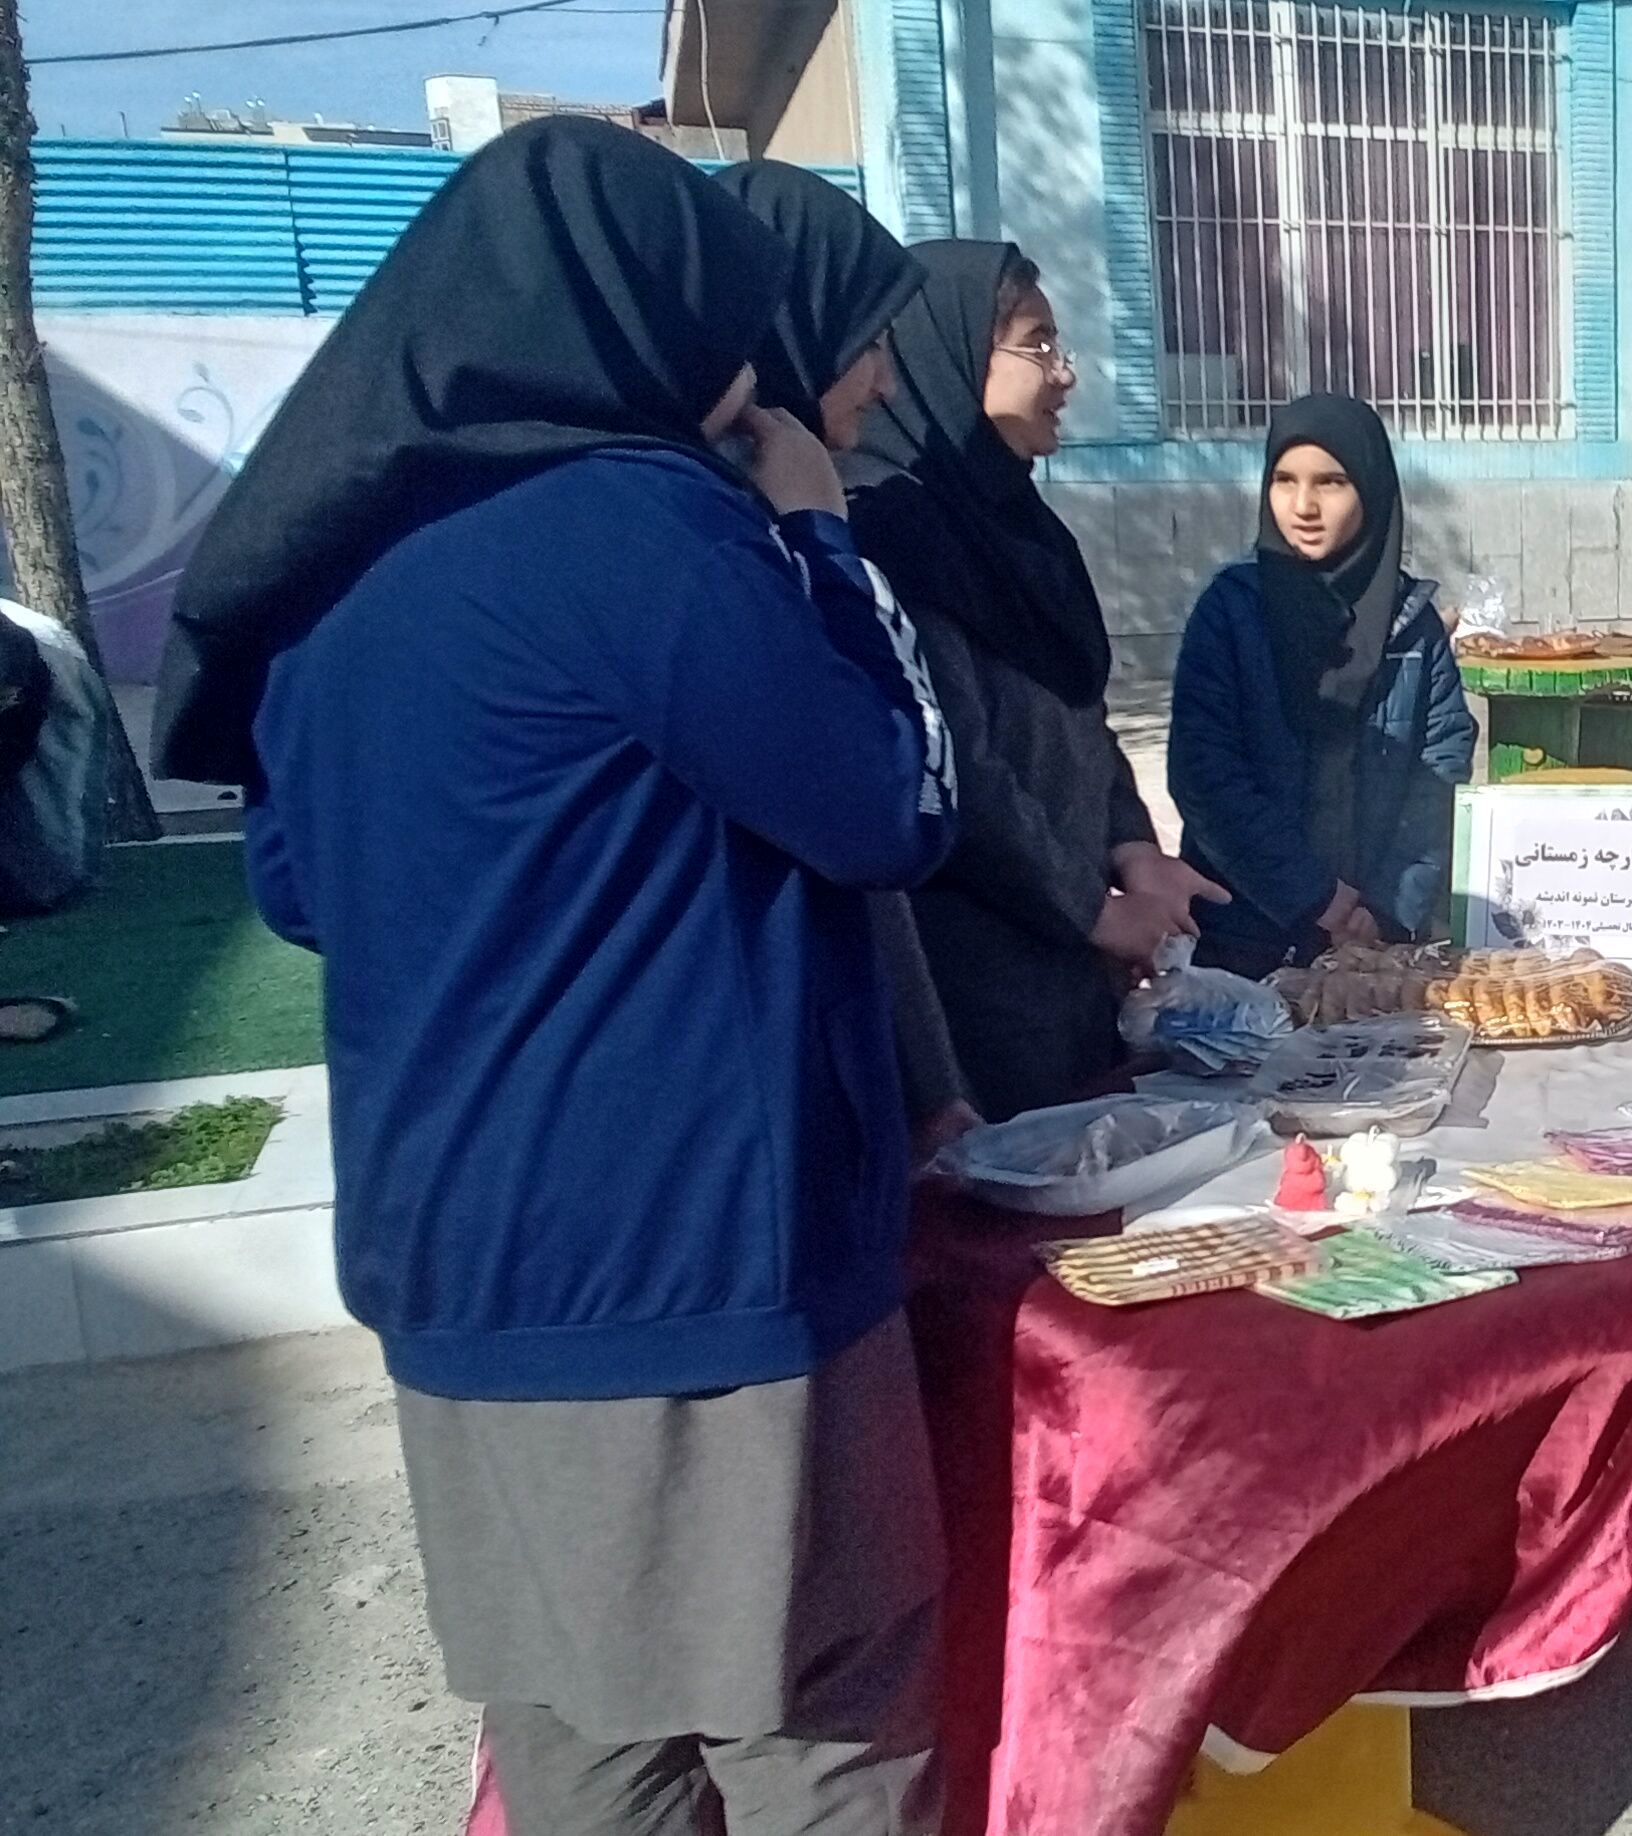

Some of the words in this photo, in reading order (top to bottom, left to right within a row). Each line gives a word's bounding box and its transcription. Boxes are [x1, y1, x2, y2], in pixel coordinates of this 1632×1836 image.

[1515, 843, 1588, 869] زمستانی
[1536, 891, 1570, 904] اندیشه
[1572, 891, 1598, 906] نمونه
[1592, 922, 1620, 932] تحصیلی
